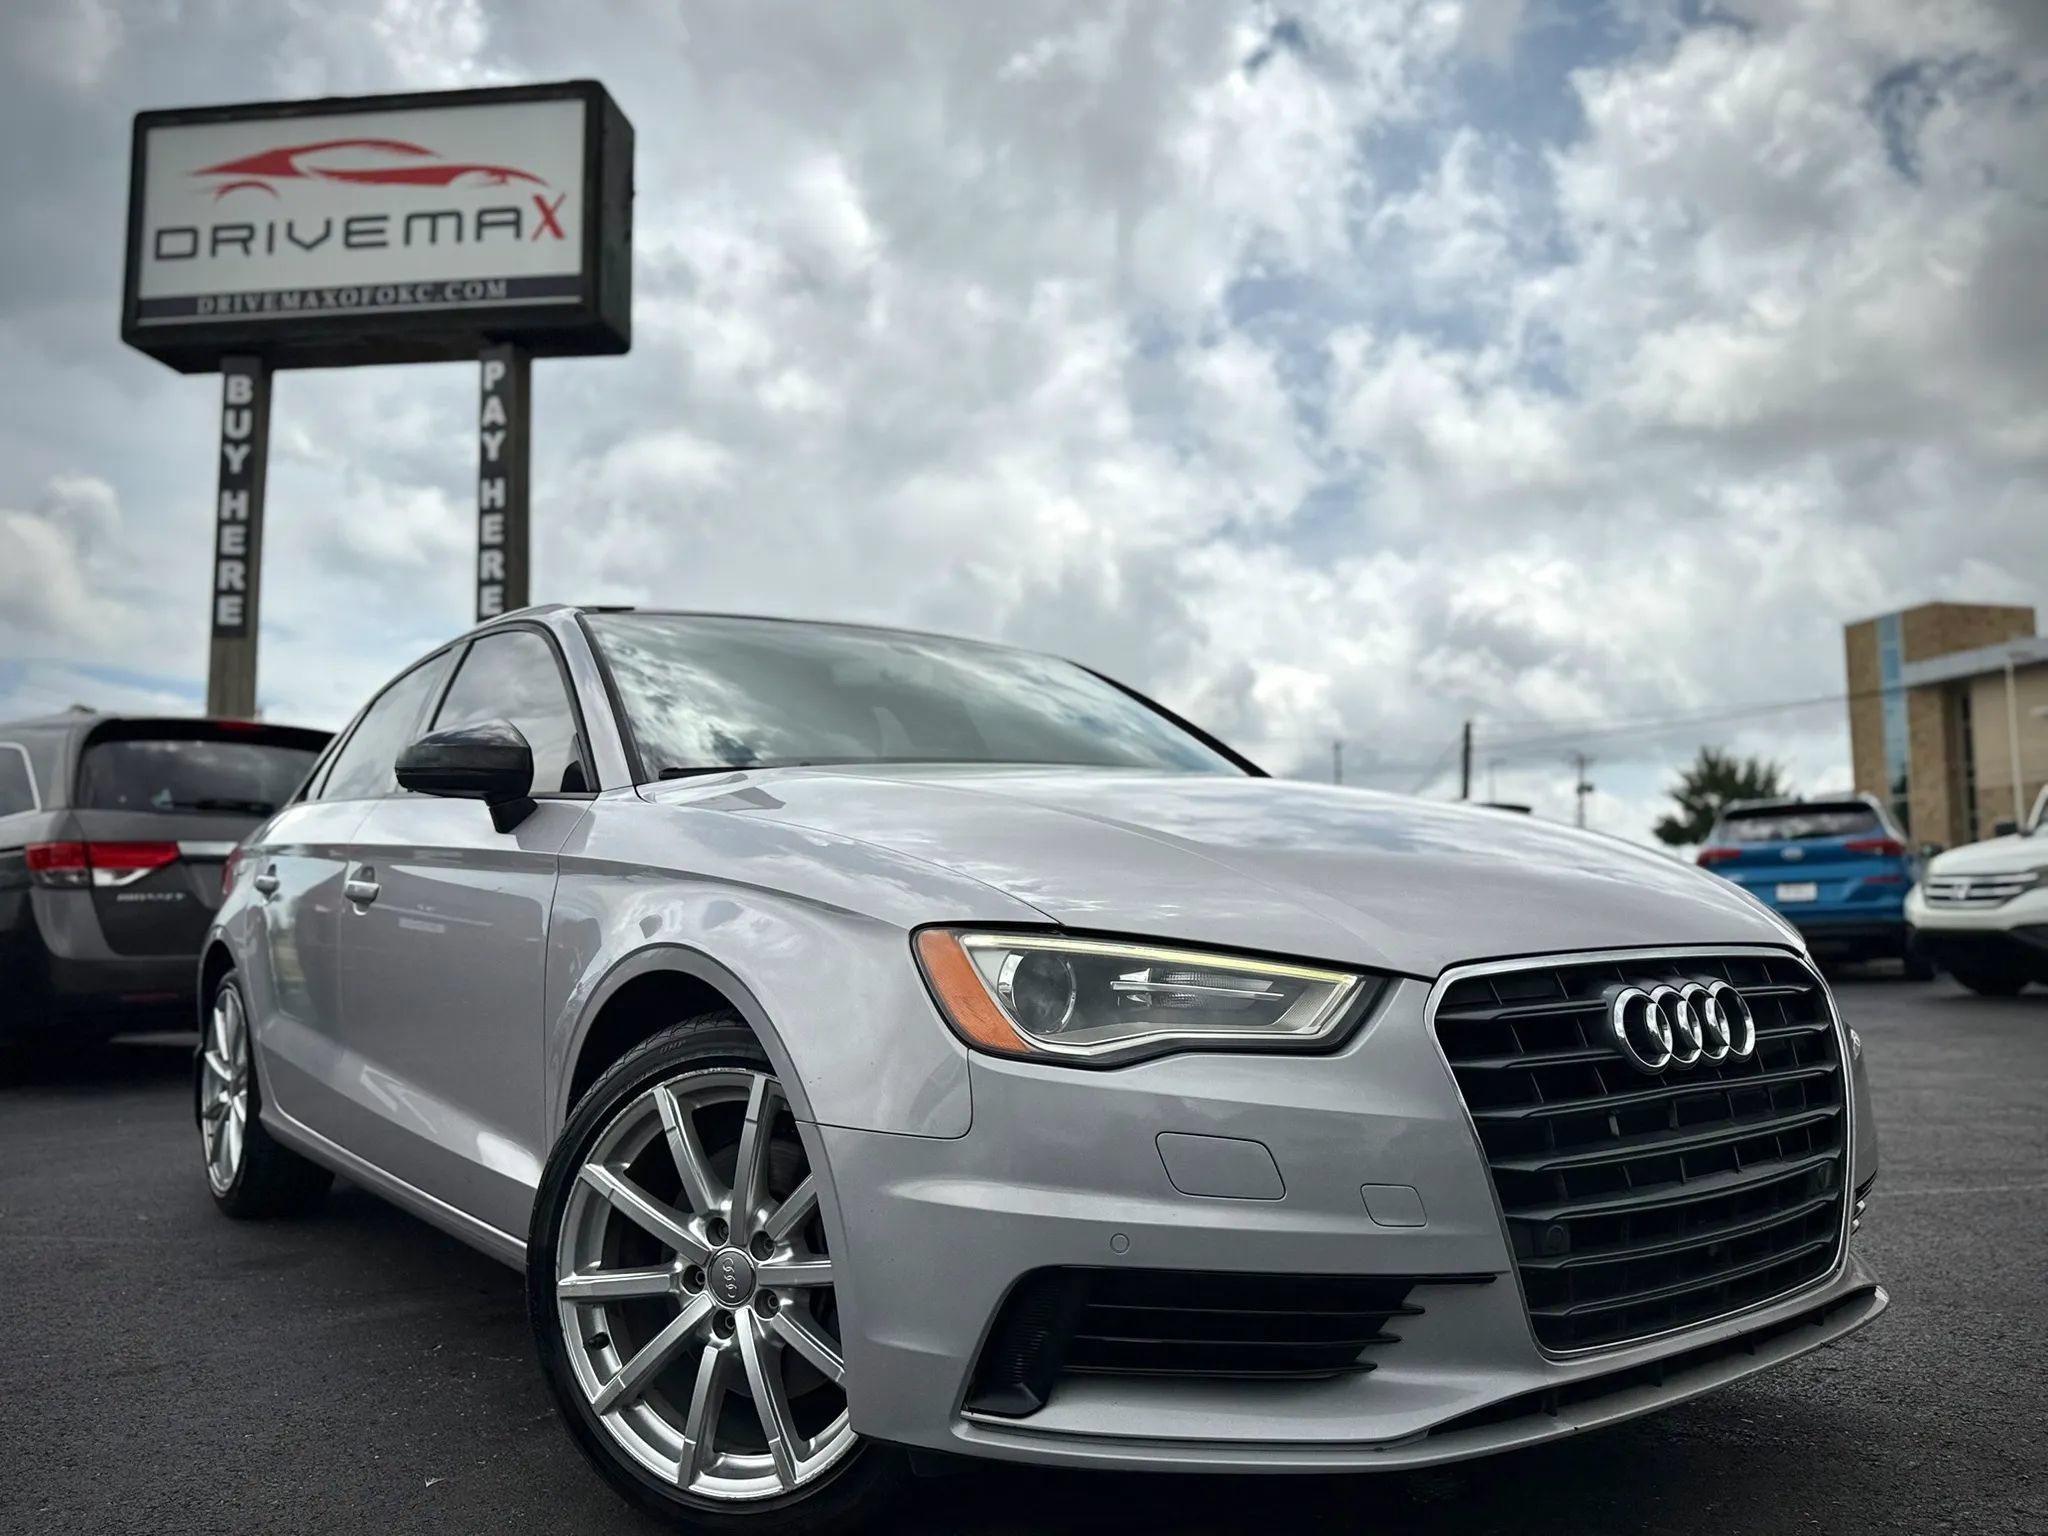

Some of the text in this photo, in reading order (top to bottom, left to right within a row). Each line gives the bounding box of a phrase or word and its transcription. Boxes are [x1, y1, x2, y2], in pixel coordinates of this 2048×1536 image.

[154, 193, 567, 261] DRIVEMAX
[216, 374, 254, 627] BUY HERE
[479, 360, 508, 617] PAY HERE
